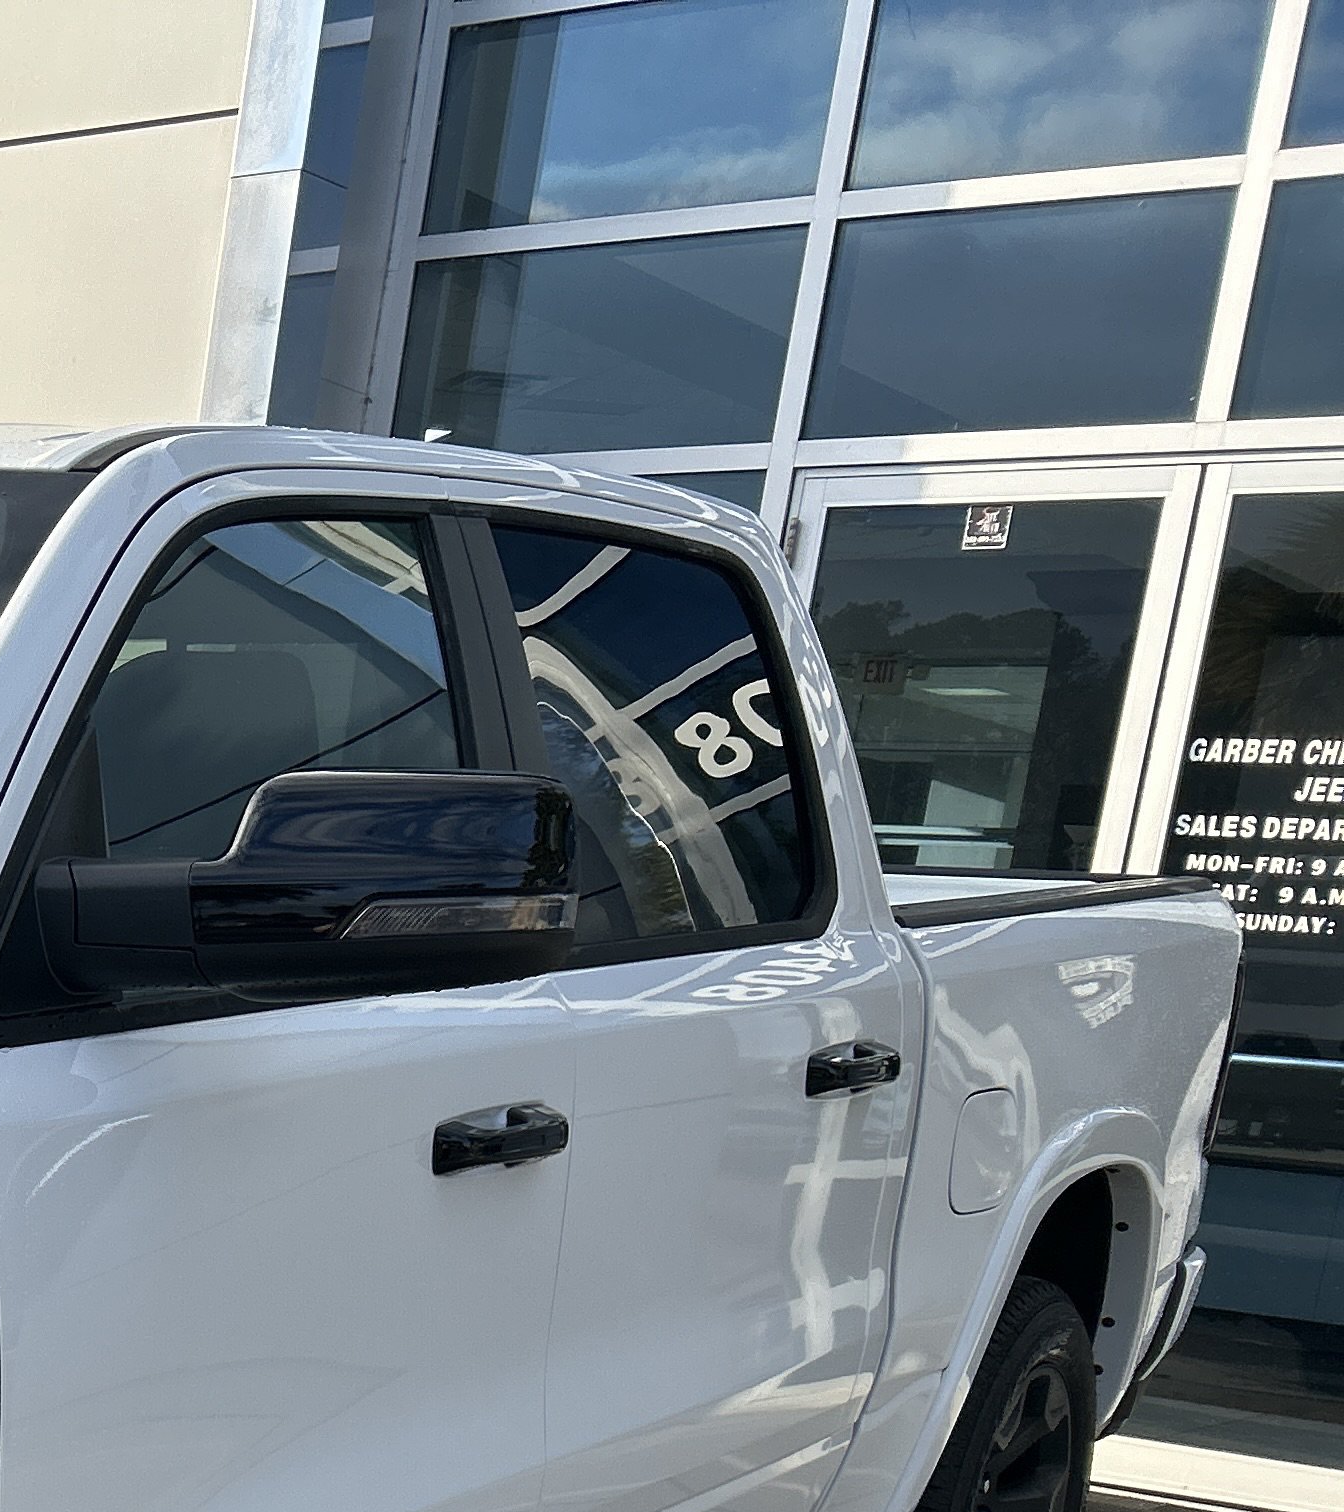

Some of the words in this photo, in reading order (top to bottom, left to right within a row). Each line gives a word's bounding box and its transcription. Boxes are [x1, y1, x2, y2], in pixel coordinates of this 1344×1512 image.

[863, 660, 898, 683] EXIT
[1189, 738, 1297, 764] GARBER
[1176, 814, 1257, 838] SALES
[1185, 853, 1304, 875] MON-FRI:
[1311, 859, 1327, 876] 9
[1213, 884, 1259, 902] AT:
[1278, 887, 1294, 904] 9
[1235, 914, 1336, 935] SUNDAY:
